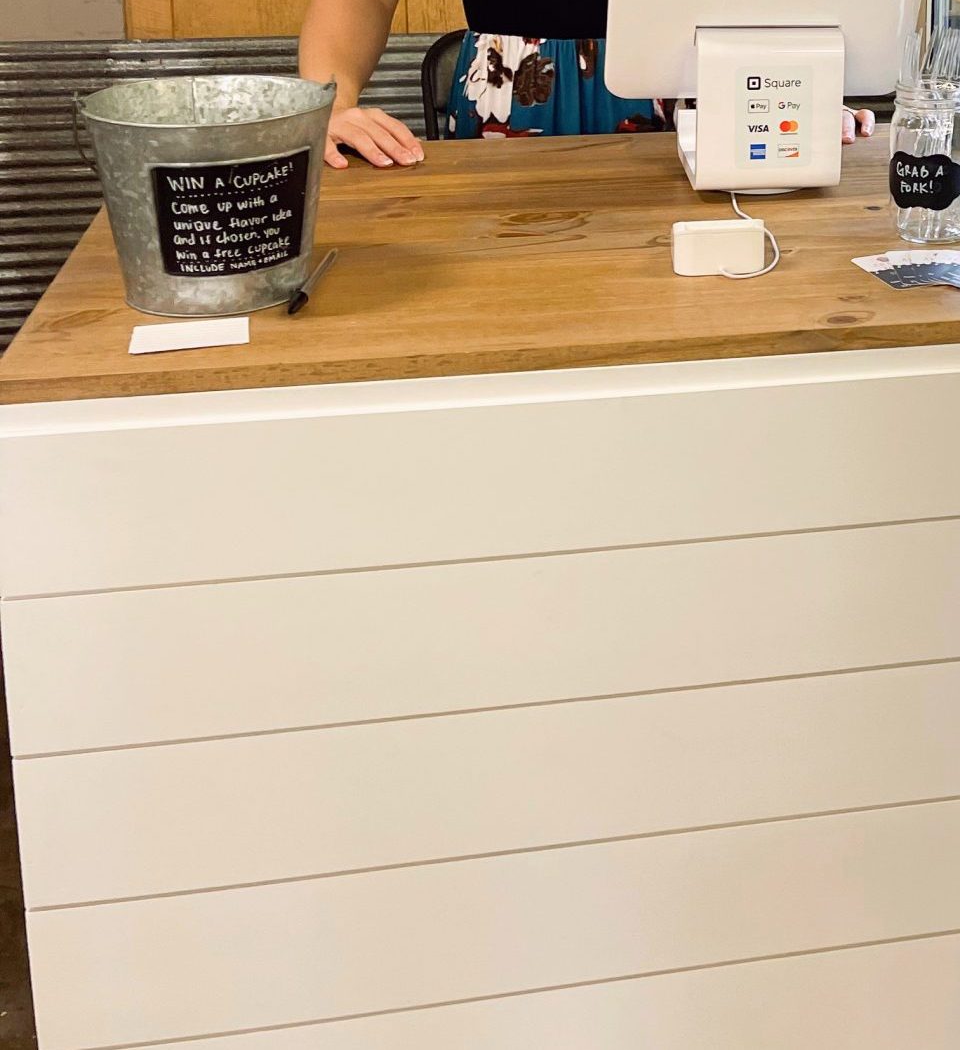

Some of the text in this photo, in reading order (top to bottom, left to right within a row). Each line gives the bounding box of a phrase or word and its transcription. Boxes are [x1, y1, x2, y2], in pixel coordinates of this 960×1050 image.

[764, 78, 801, 89] Square
[787, 102, 800, 110] Pay
[896, 161, 944, 178] GRAB A
[166, 176, 204, 191] WIN
[216, 177, 225, 189] A
[900, 181, 934, 194] FORK!
[171, 201, 210, 214] Come
[236, 195, 265, 210] with
[270, 194, 278, 203] a
[228, 215, 268, 228] flavor
[263, 227, 280, 239] you
[213, 248, 241, 258] free
[180, 263, 225, 272] INCLUDE
[230, 259, 257, 269] NAME
[263, 250, 288, 263] EMAIL
